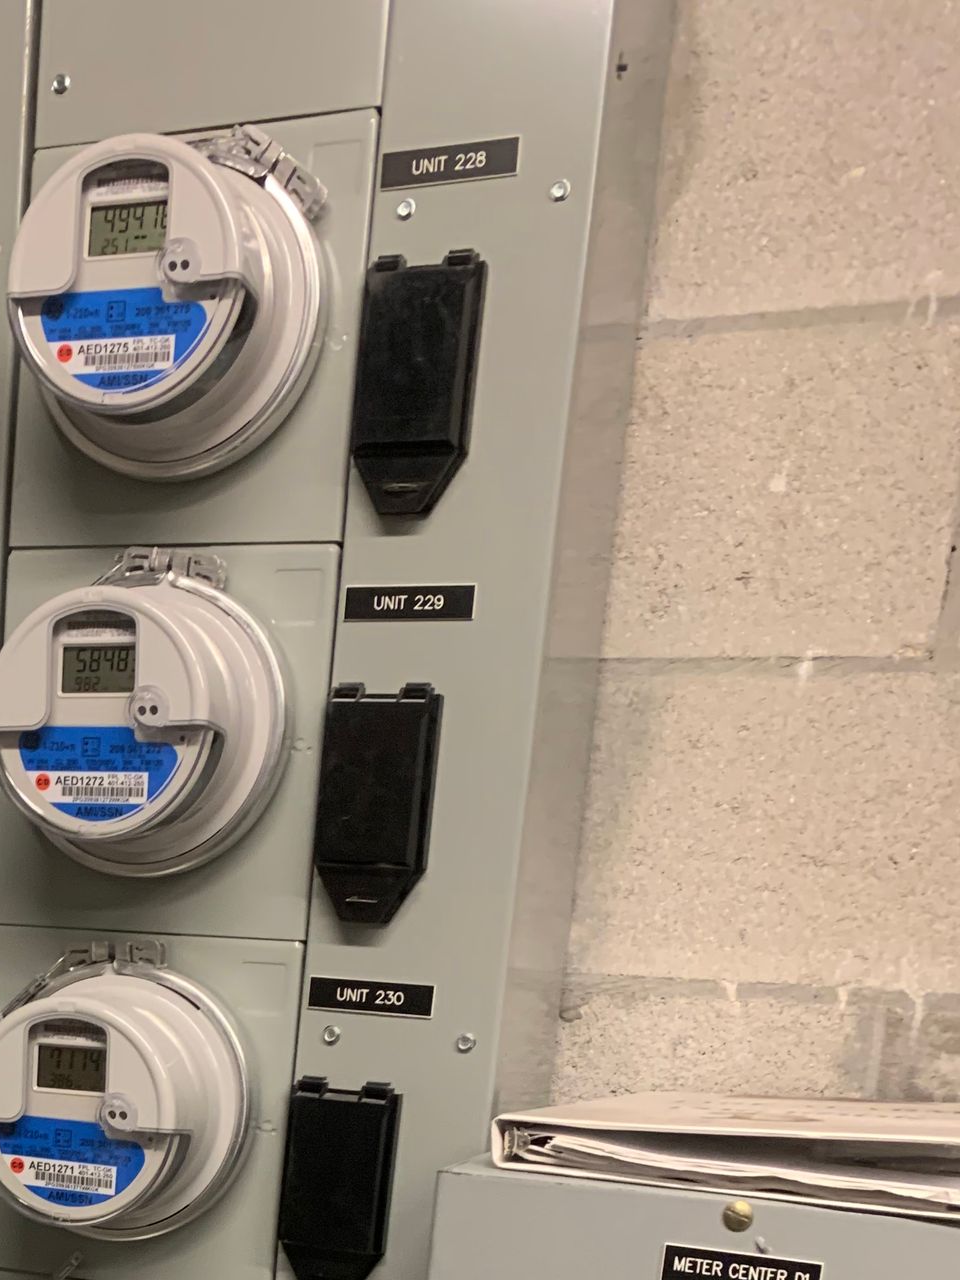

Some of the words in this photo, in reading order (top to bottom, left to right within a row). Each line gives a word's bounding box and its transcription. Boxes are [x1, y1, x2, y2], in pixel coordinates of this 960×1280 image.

[412, 155, 449, 175] UNIT
[455, 151, 486, 170] 228
[77, 342, 129, 356] AED1275
[374, 595, 409, 610] UNIT
[414, 595, 445, 610] 229
[76, 648, 135, 673] 5848
[55, 776, 105, 786] AED1272
[336, 987, 369, 1003] UNIT
[375, 990, 405, 1006] 230
[28, 1160, 75, 1175] AED1271
[674, 1256, 723, 1277] METER
